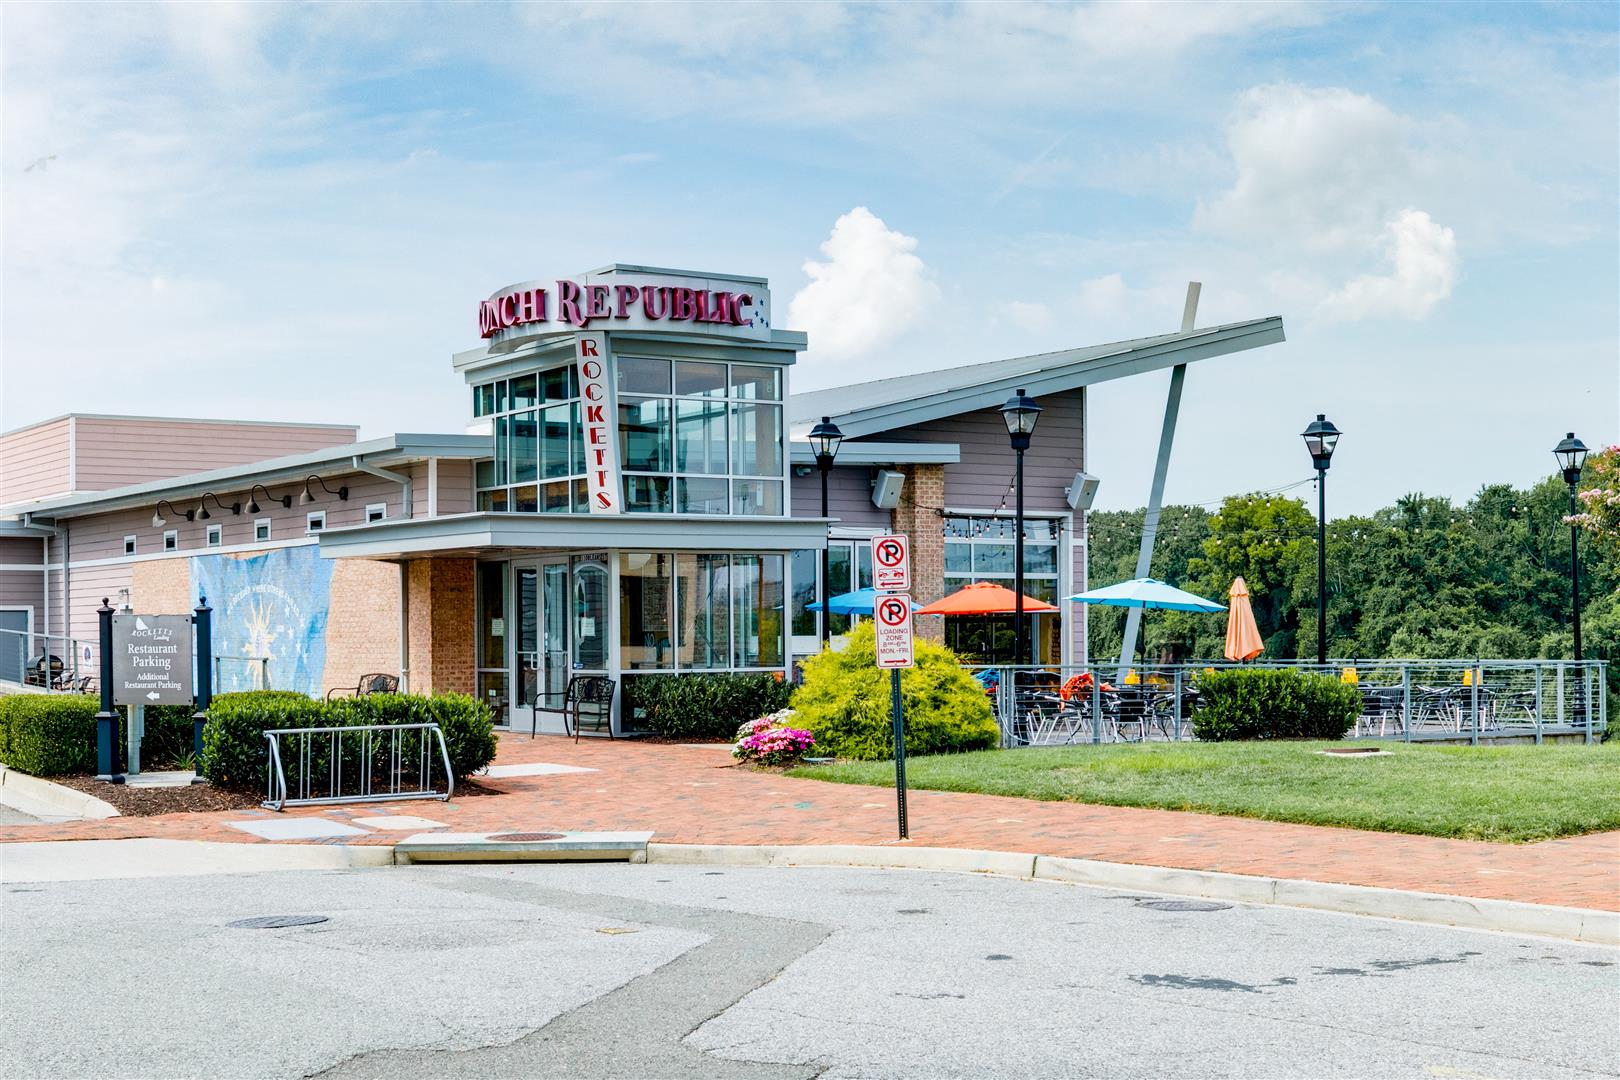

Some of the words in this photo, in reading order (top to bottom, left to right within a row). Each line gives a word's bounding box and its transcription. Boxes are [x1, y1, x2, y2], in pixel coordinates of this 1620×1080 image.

[479, 288, 546, 339] ONCH
[555, 279, 753, 328] REPUBLIC
[581, 339, 612, 509] ROCKETTS
[127, 643, 178, 654] Restaurant
[133, 655, 172, 670] Parking
[136, 672, 170, 681] Additional
[158, 680, 182, 691] Parking
